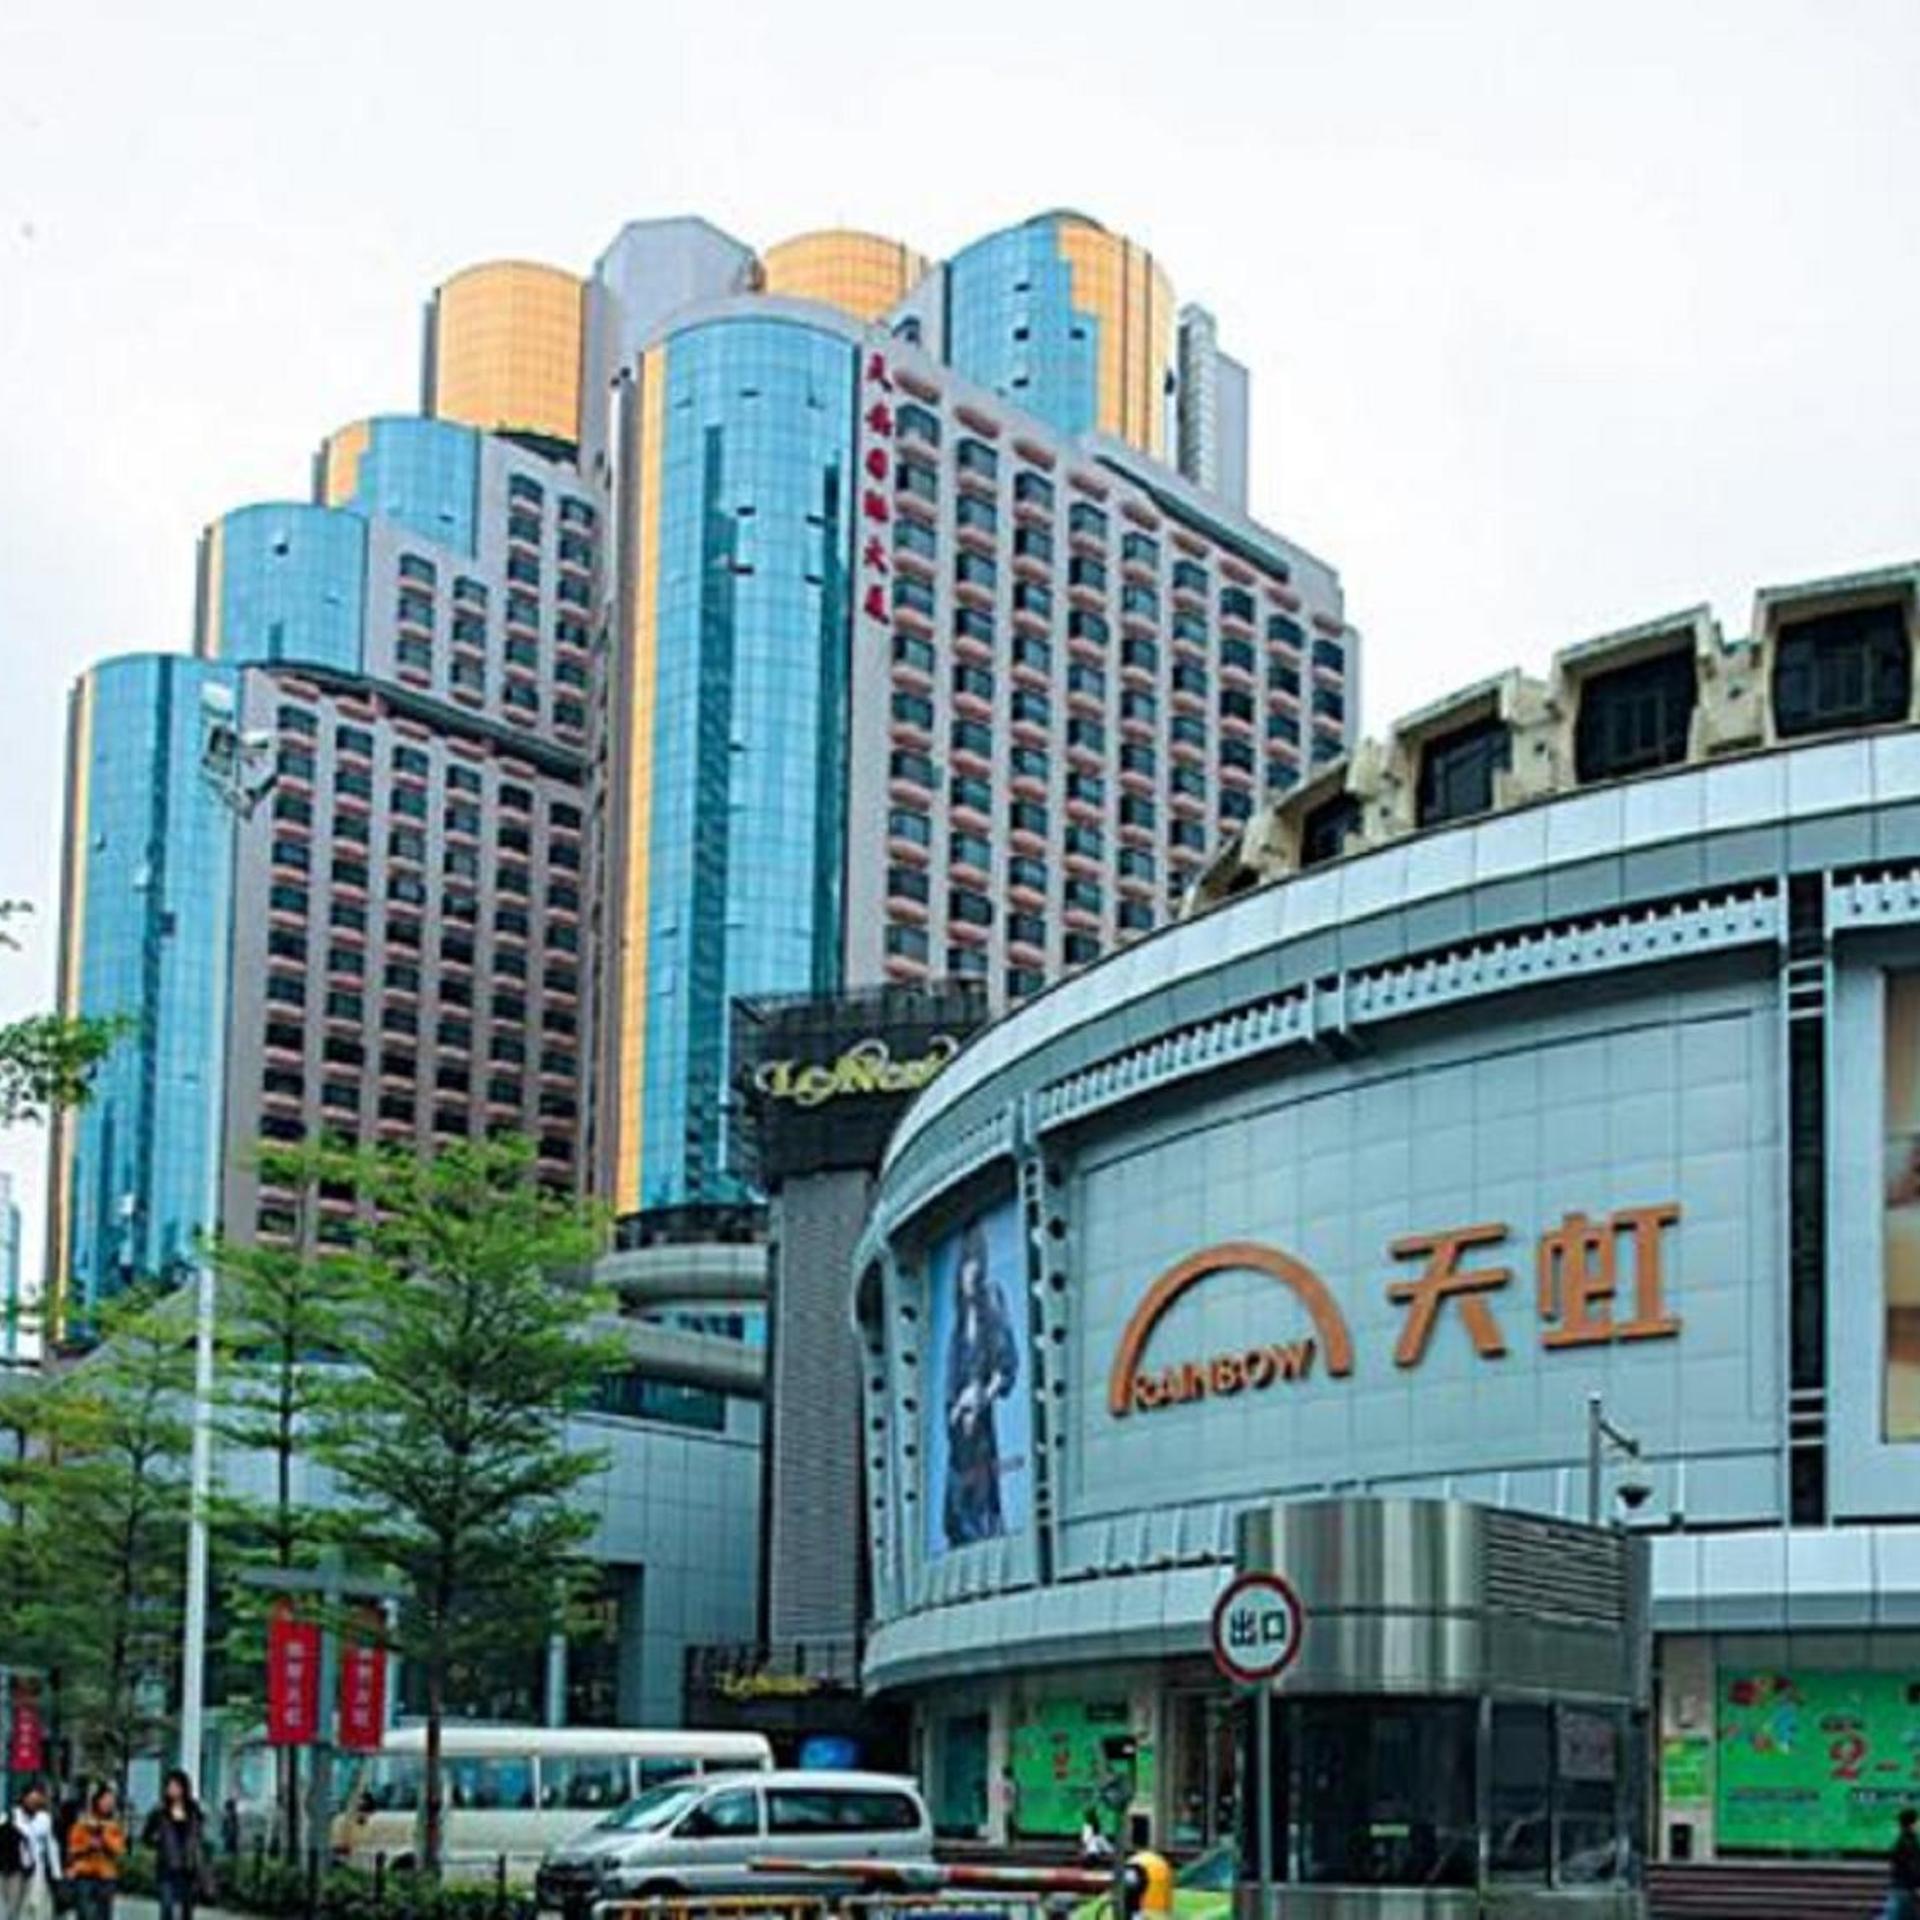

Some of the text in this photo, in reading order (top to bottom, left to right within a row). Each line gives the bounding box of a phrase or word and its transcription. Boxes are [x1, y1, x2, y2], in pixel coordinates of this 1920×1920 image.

[1386, 1202, 1682, 1368] 天虹
[1134, 1338, 1317, 1412] RAINBOW
[1229, 1608, 1286, 1647] 出口
